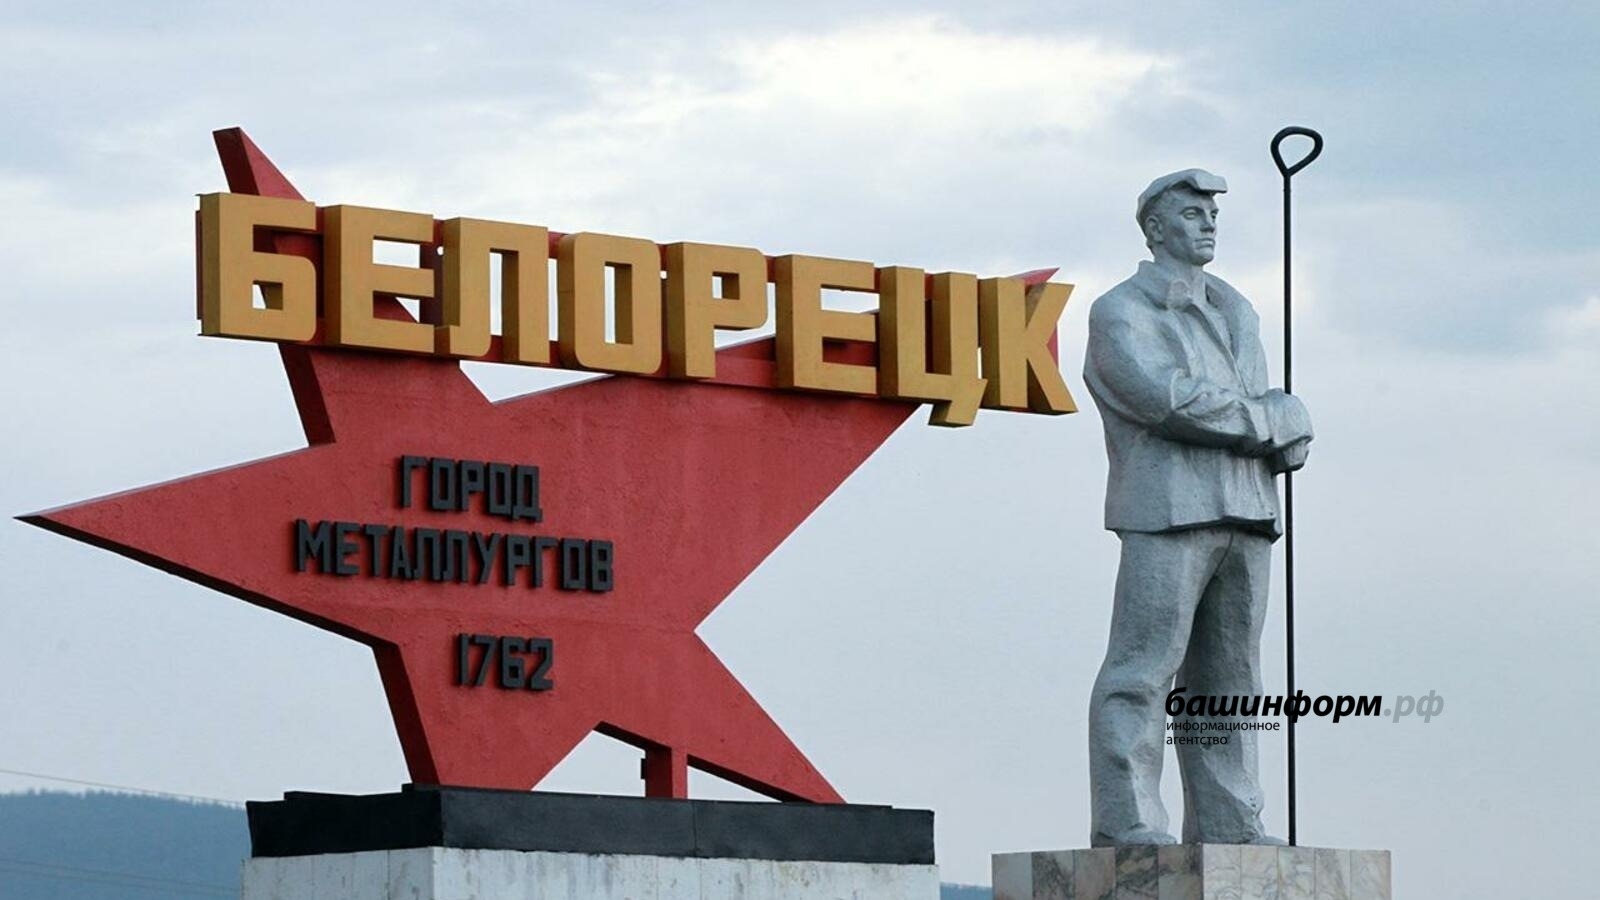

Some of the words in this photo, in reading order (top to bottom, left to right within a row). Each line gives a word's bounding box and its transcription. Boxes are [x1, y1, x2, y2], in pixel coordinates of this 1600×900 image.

[198, 192, 1078, 427] БЕЛОРЕЦК
[398, 455, 543, 523] ГОРОД
[294, 519, 613, 593] МЕТАЛЛУРГОВ
[455, 633, 553, 691] 1762
